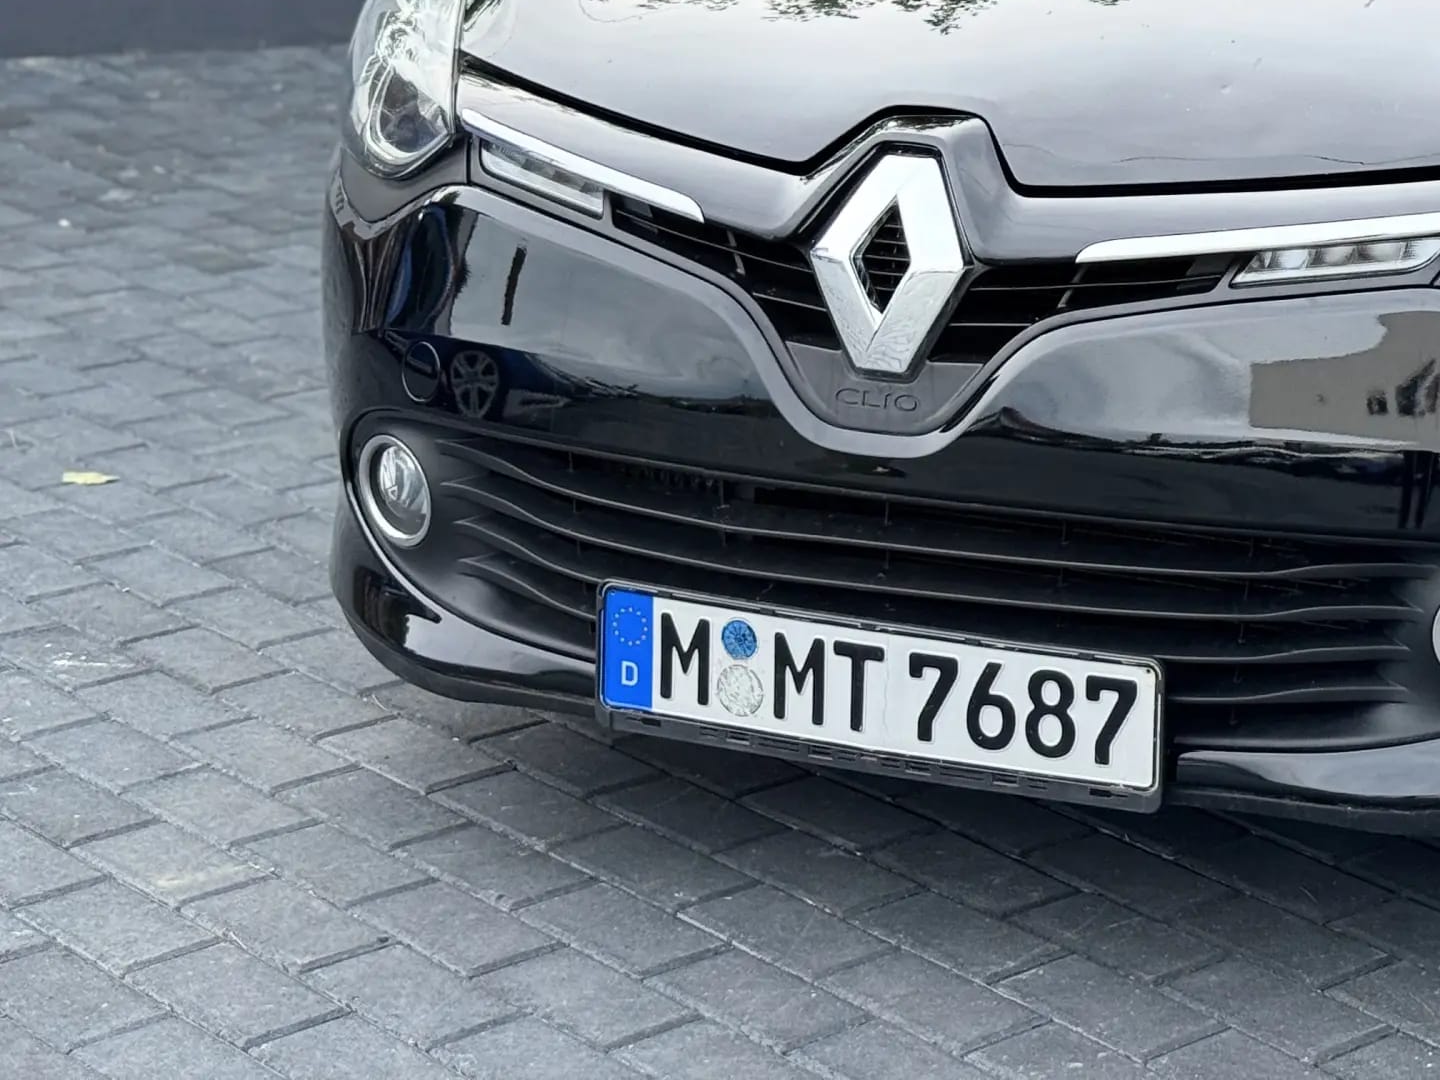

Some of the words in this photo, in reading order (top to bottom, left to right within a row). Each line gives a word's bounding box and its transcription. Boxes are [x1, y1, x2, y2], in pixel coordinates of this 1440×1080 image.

[834, 386, 922, 413] CLIO
[620, 660, 640, 687] D
[659, 612, 712, 707] M
[773, 631, 887, 733] MT
[907, 651, 1140, 766] 7687
